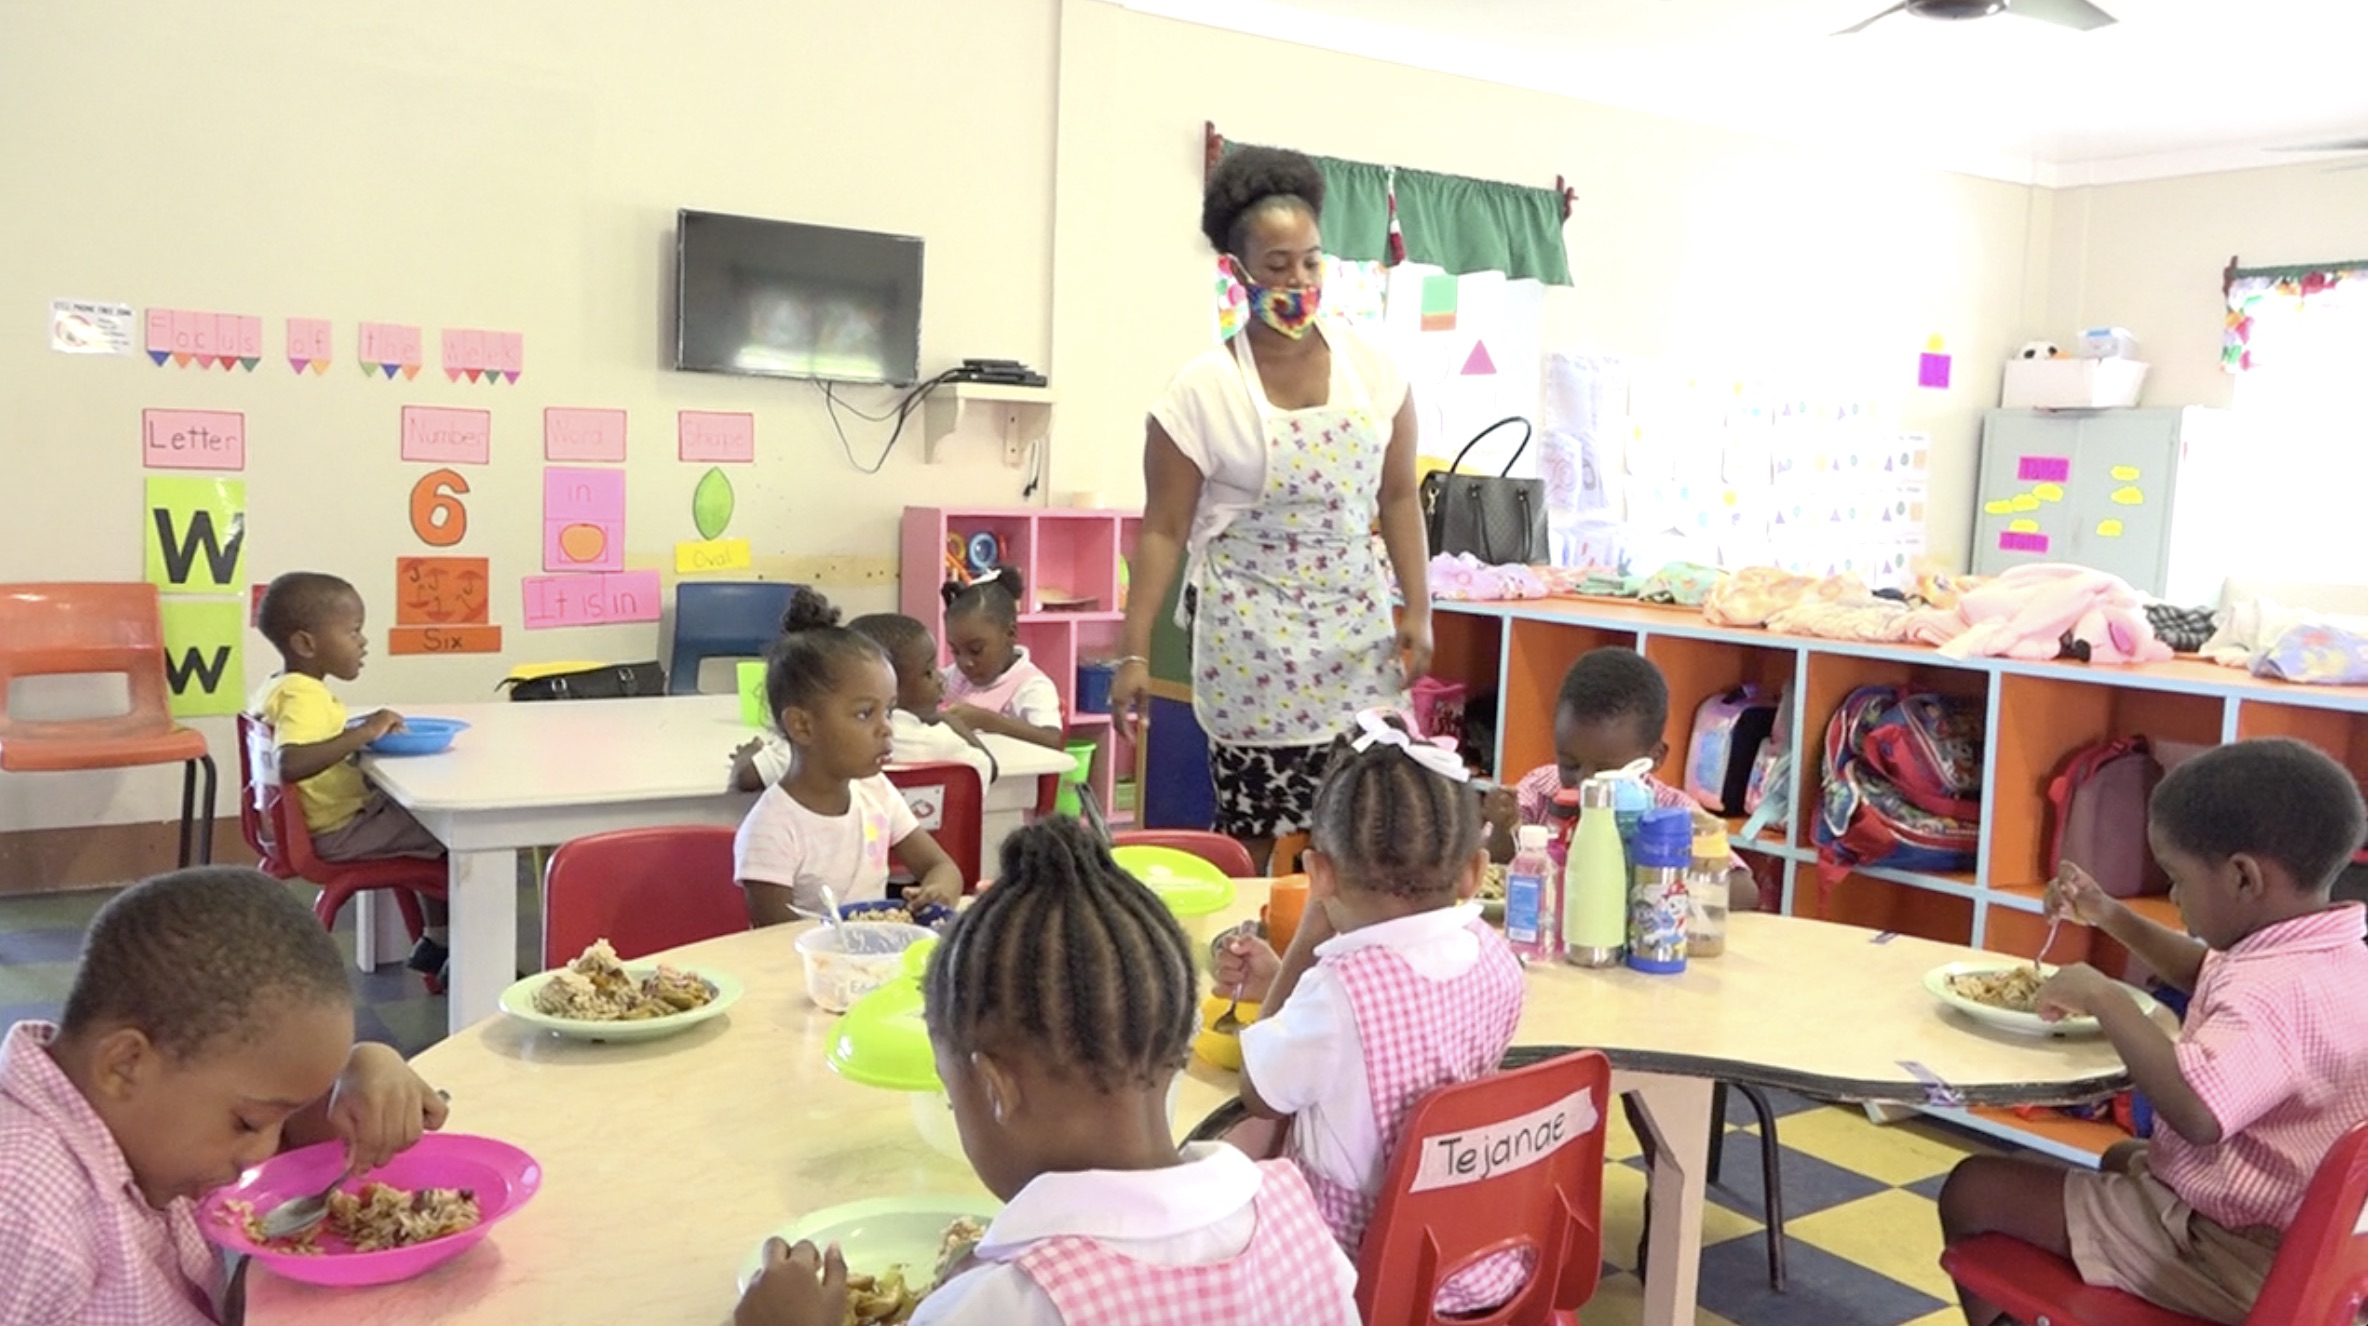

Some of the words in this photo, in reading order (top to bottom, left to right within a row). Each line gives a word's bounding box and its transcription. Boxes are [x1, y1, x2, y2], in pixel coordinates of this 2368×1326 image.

[292, 330, 327, 353] of
[366, 331, 416, 361] the
[150, 419, 237, 451] Letter
[409, 417, 486, 447] Number
[550, 418, 604, 446] Word
[683, 420, 747, 450] Shape
[408, 467, 470, 547] 6
[568, 482, 592, 503] in
[153, 507, 244, 584] W
[693, 545, 734, 569] Oval
[528, 578, 570, 621] It
[582, 595, 602, 618] is
[613, 590, 638, 615] in
[423, 628, 463, 651] Six
[1438, 1112, 1565, 1180] Tejanae
